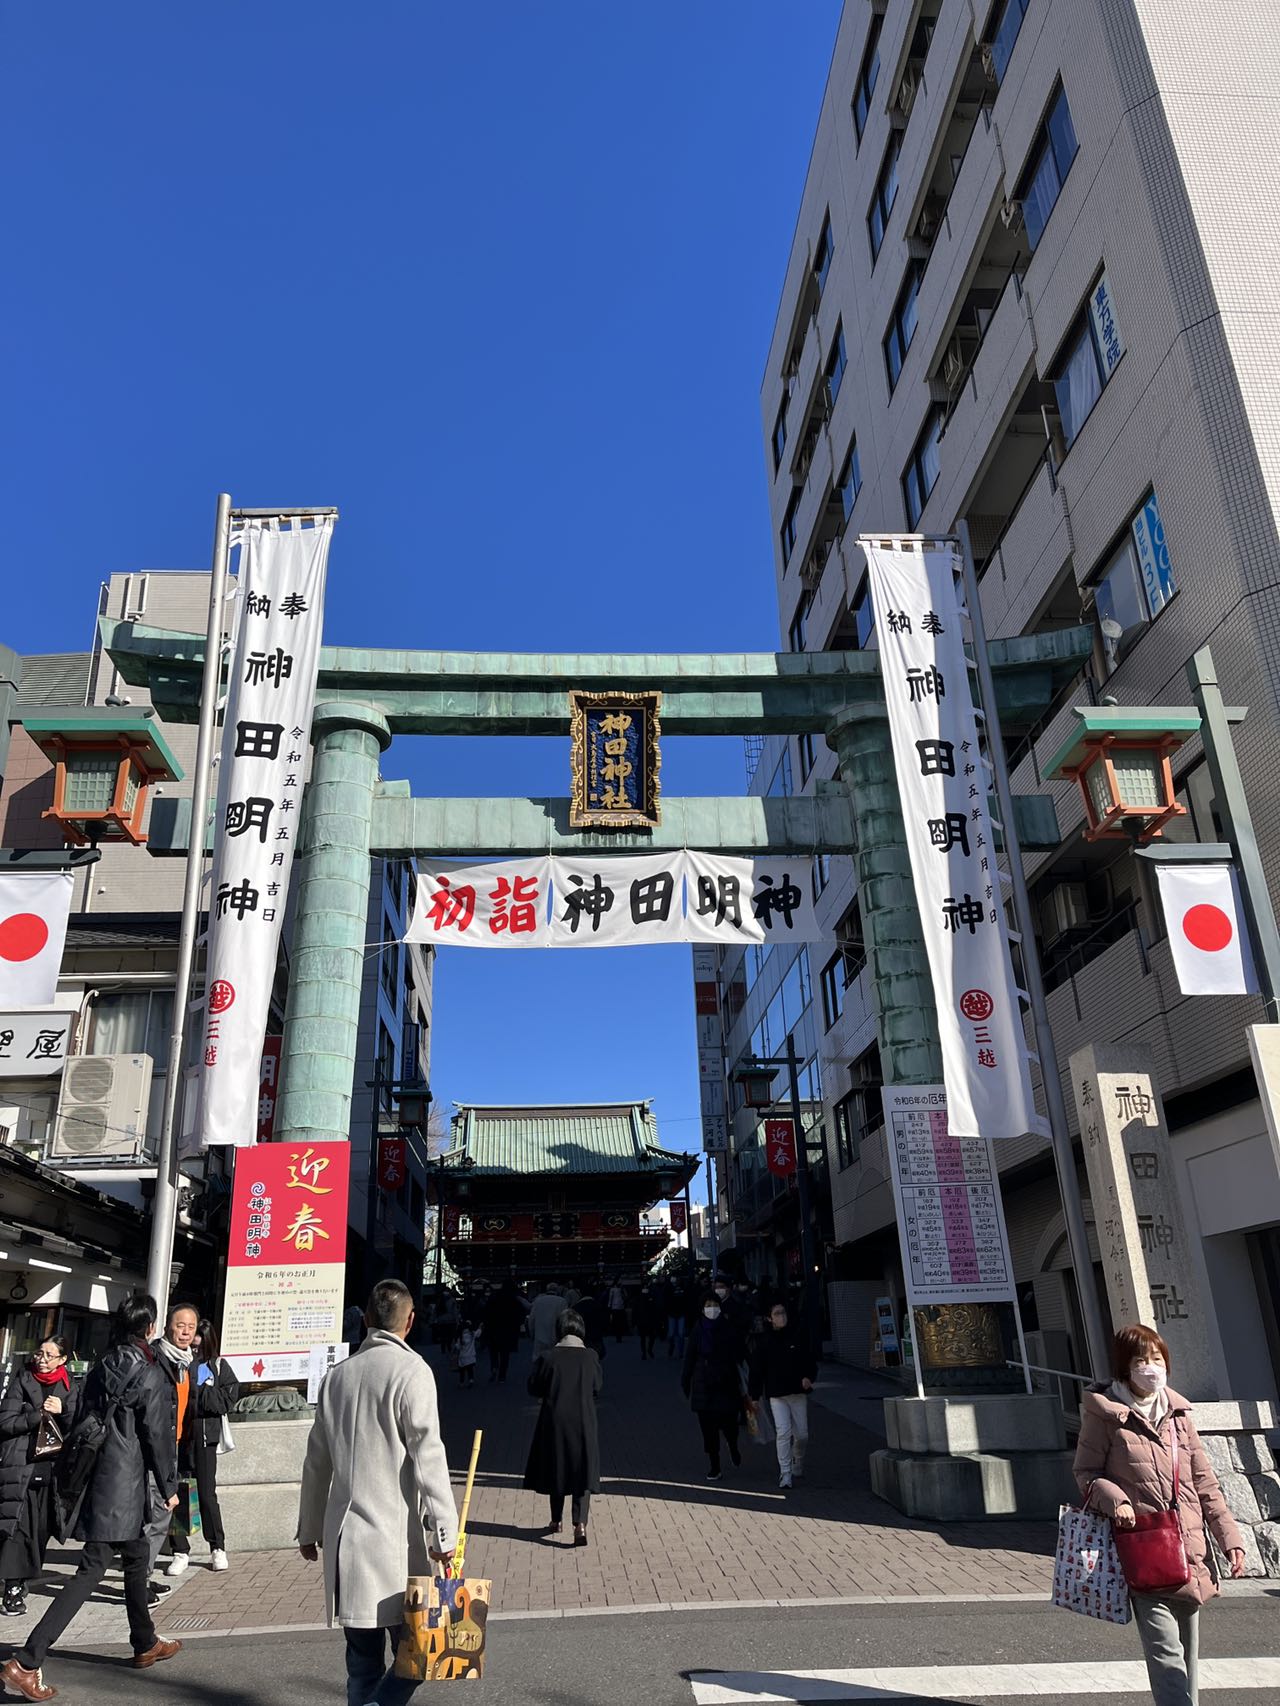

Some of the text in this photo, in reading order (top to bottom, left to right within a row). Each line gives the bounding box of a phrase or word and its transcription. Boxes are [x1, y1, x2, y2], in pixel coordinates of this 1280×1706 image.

[246, 591, 309, 620] 奉納
[887, 609, 945, 637] 奉納
[599, 711, 633, 809] 神田神社
[262, 726, 304, 922] 令和五年五月吉日
[959, 740, 998, 925] 令和五年五月吉日
[425, 871, 802, 934] 初詣 神田明神
[204, 1019, 220, 1067] 三越
[974, 1025, 998, 1068] 三越
[384, 1144, 400, 1182] 迎春
[772, 1127, 790, 1166] 迎春
[282, 1148, 333, 1252] 迎春
[1115, 1085, 1189, 1325] 神田神社
